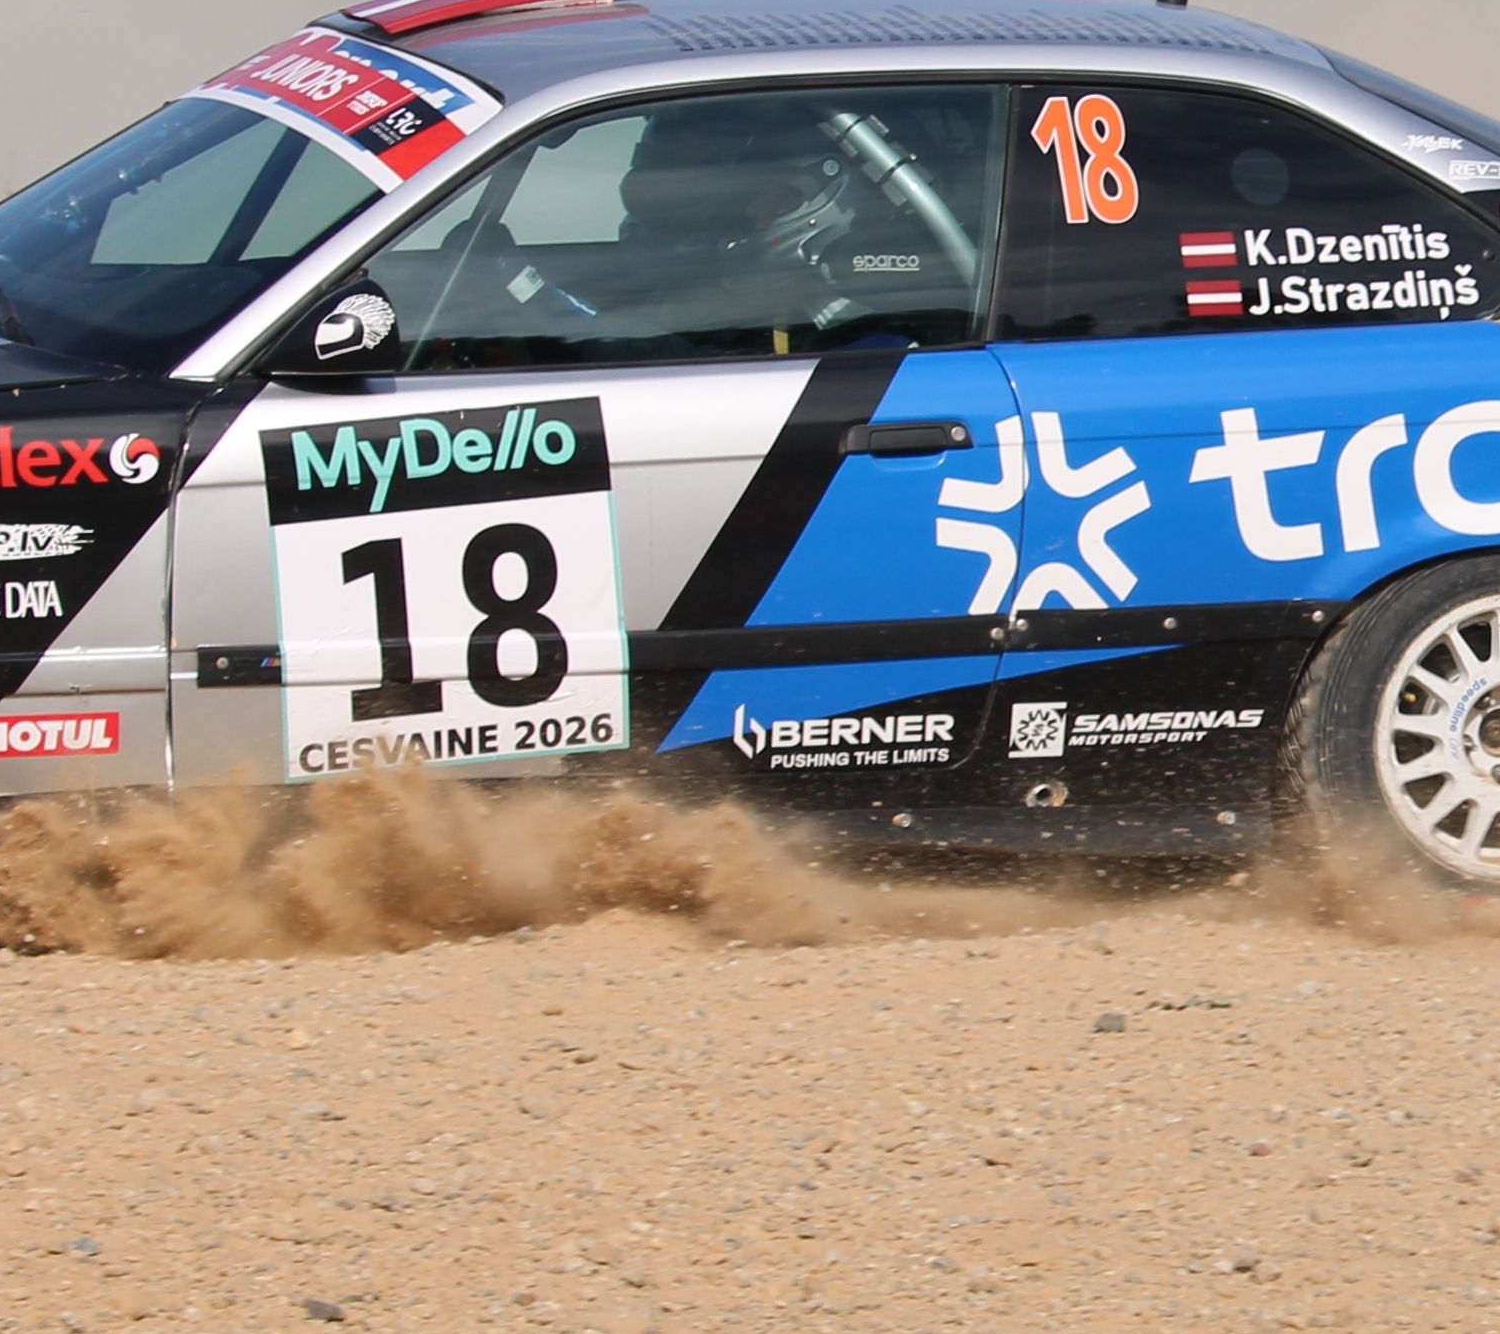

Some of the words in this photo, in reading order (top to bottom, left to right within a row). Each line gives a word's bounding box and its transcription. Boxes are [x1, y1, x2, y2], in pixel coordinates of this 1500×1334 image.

[252, 53, 359, 101] JUNIORS
[1030, 94, 1139, 224] 18
[852, 254, 919, 271] sparco
[1244, 223, 1450, 267] K.Dzenītis
[1249, 263, 1480, 320] J.Strazdiņš
[291, 408, 576, 513] MyDello
[5, 580, 63, 619] DATA
[341, 523, 569, 722] 18
[300, 724, 498, 773] CESVAINE
[514, 713, 613, 751] 2026
[771, 714, 955, 748] BERNER
[1068, 731, 1208, 746] MOTORSPORT
[1072, 709, 1265, 733] SAMSONAS
[770, 751, 850, 769] PUSHING
[853, 750, 888, 766] THE
[892, 748, 950, 764] LIMITS
